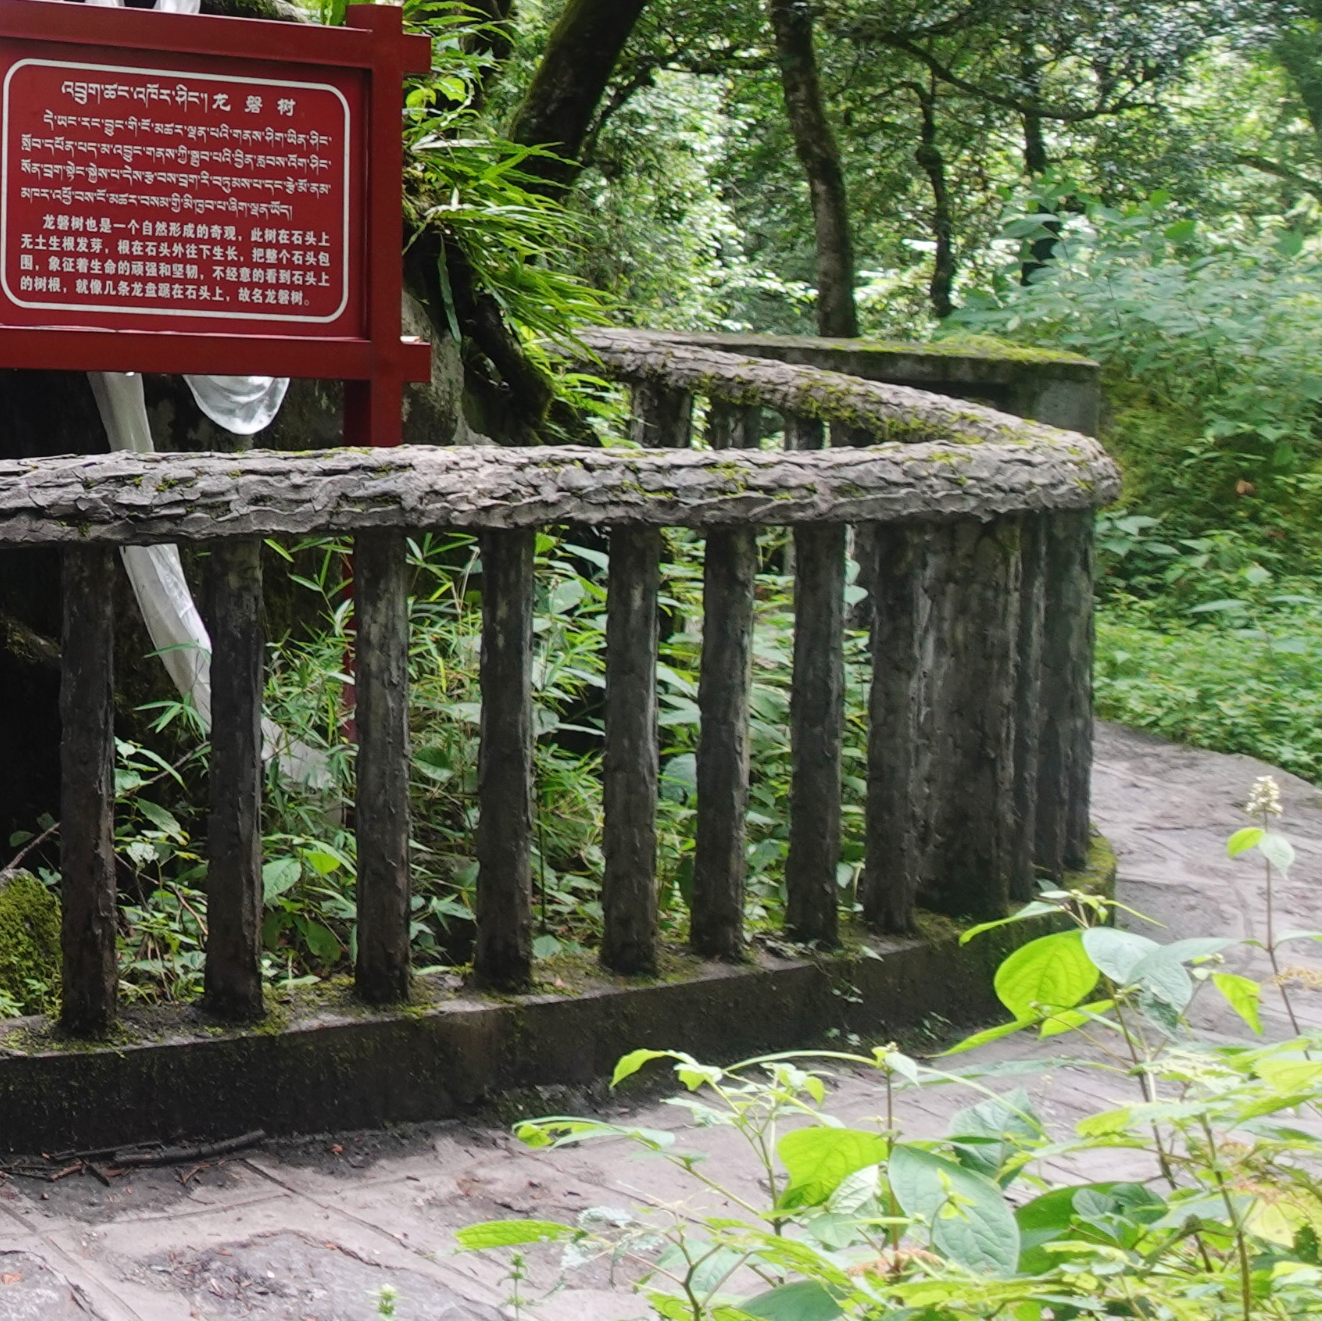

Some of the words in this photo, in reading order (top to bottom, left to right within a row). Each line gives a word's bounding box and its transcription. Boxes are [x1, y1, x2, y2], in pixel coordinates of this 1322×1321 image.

[42, 213, 331, 247] 龙磐树也是一个自然形成的奇观，此树在石头上
